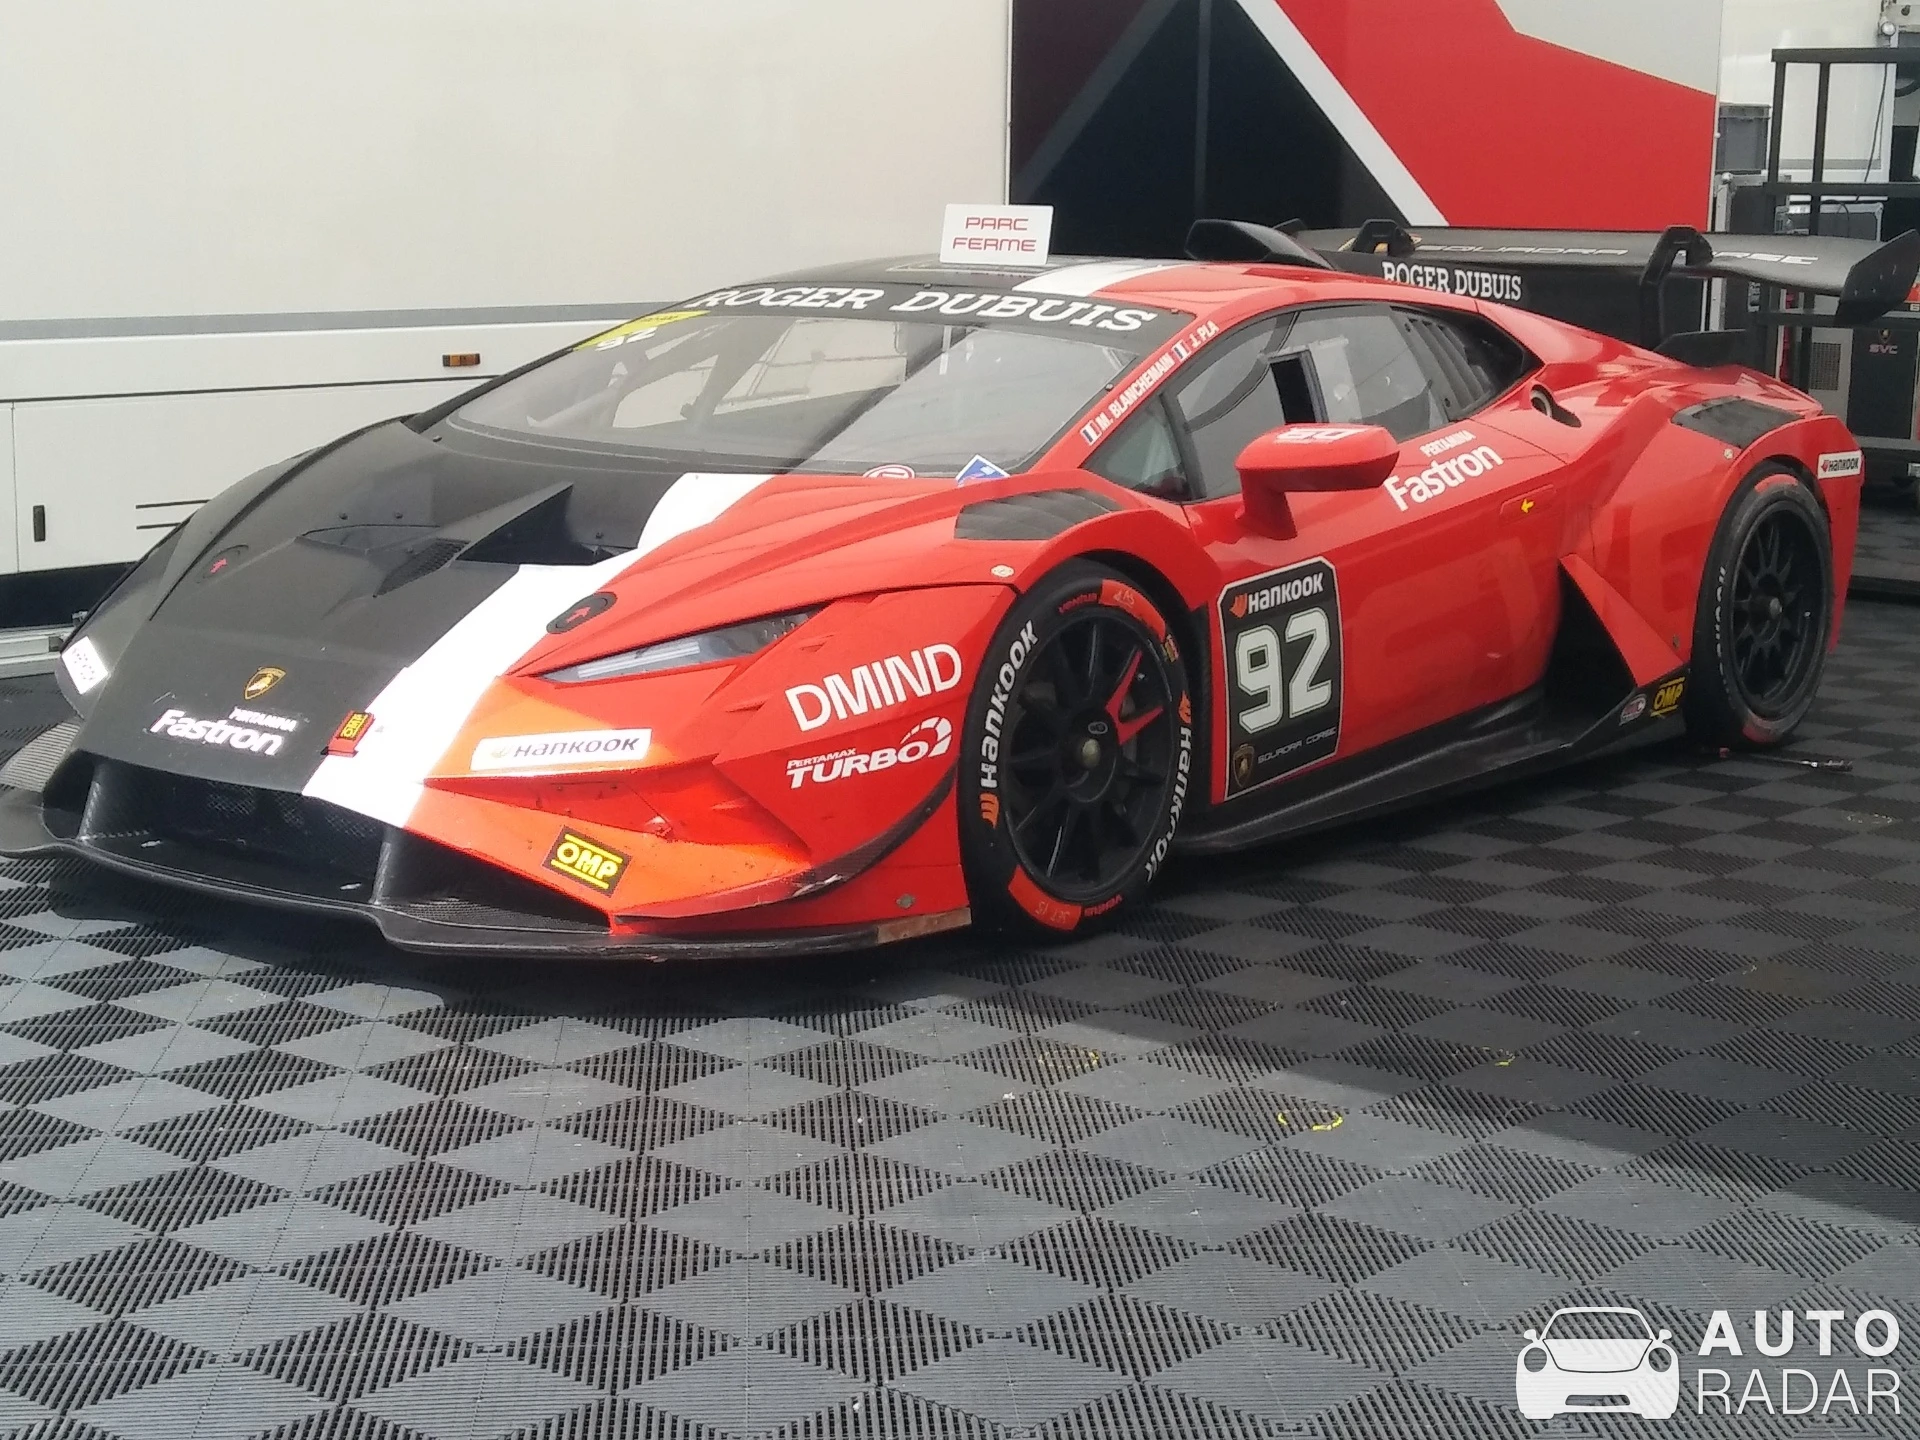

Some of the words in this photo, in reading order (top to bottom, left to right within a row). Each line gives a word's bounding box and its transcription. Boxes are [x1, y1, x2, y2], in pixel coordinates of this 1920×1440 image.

[953, 237, 1037, 252] FERME
[966, 217, 1029, 231] PARC
[1381, 261, 1450, 294] ROGER
[1454, 268, 1522, 301] DUBUIS
[683, 286, 885, 310] ROGER
[889, 290, 1158, 331] DUBUIS
[1383, 445, 1504, 512] Fastron
[784, 643, 962, 732] DMIND
[1235, 607, 1332, 734] 92
[150, 709, 283, 756] Fastron
[786, 741, 929, 789] TURBO
[787, 748, 857, 769] PERTAMAX
[556, 842, 619, 880] OMP
